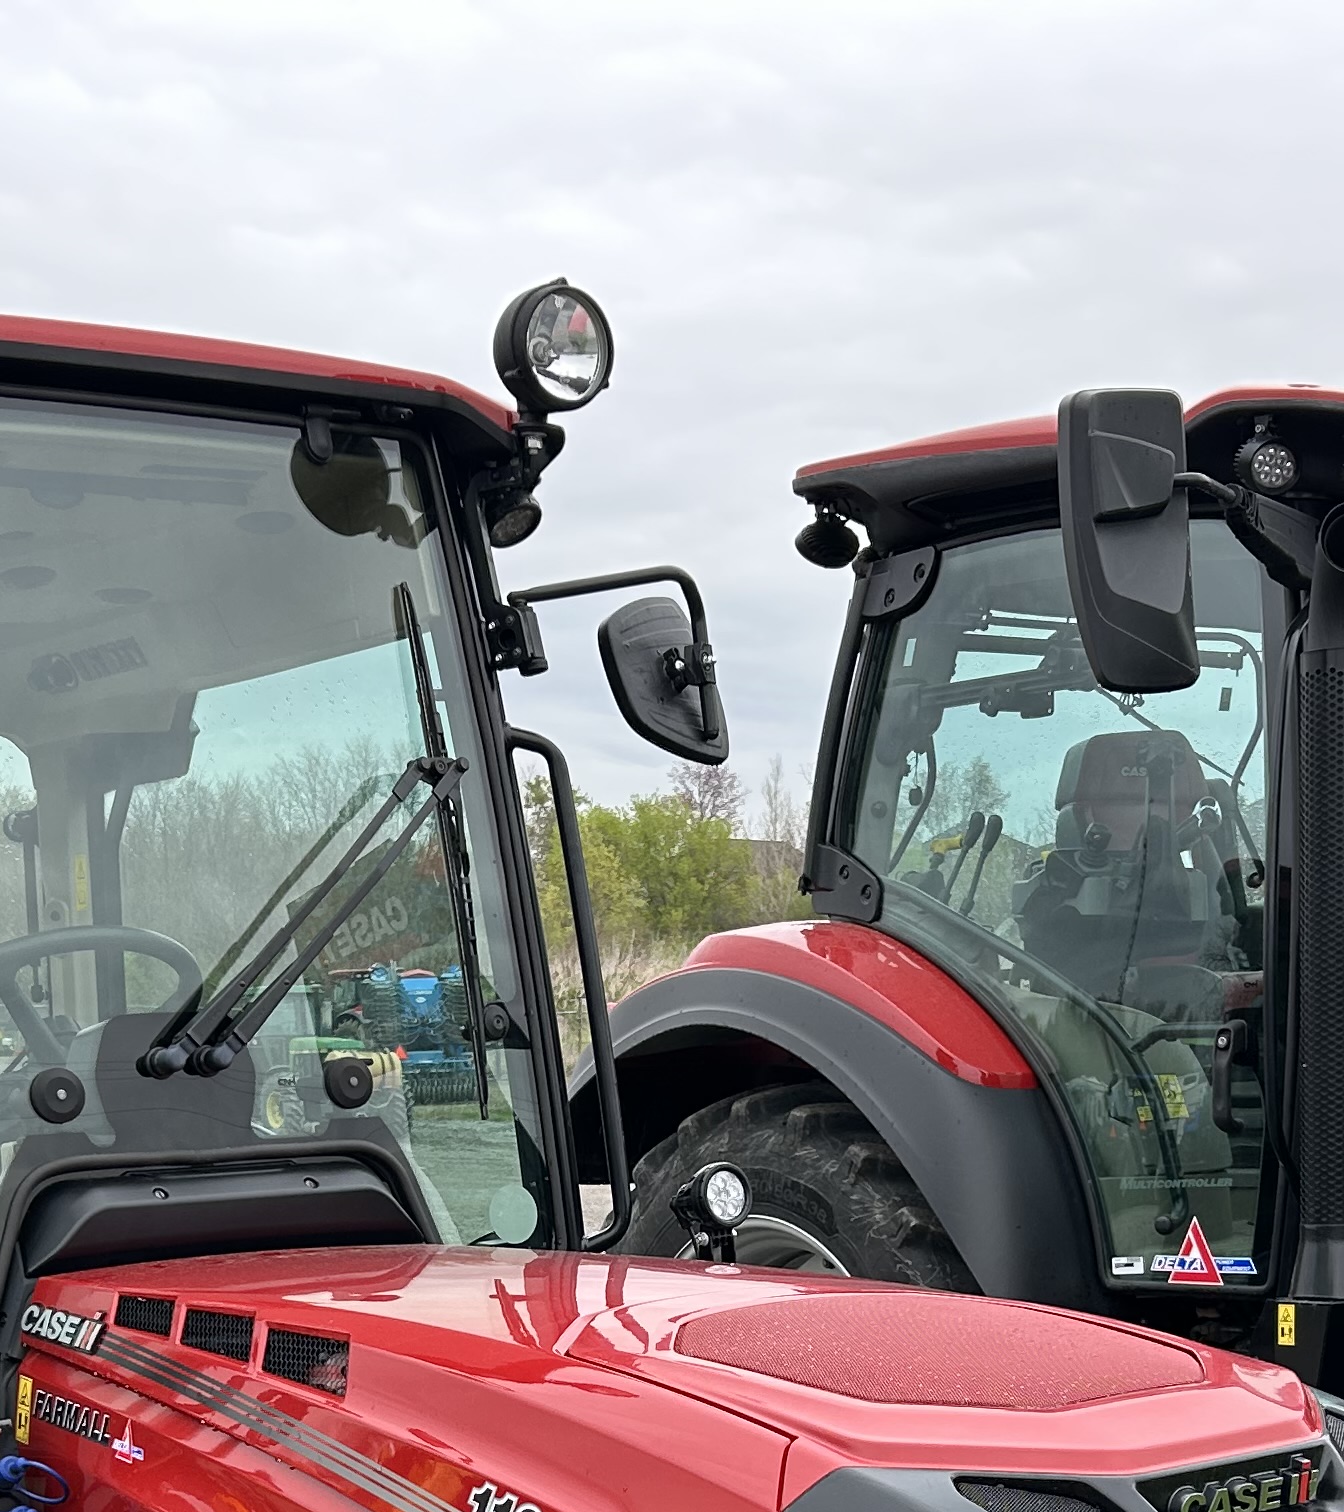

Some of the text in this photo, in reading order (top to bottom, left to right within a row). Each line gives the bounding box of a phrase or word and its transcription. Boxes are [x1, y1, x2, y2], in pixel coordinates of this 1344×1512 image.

[1154, 1256, 1207, 1271] DELTA
[20, 1304, 81, 1345] CASE
[32, 1389, 112, 1446] FARMALL
